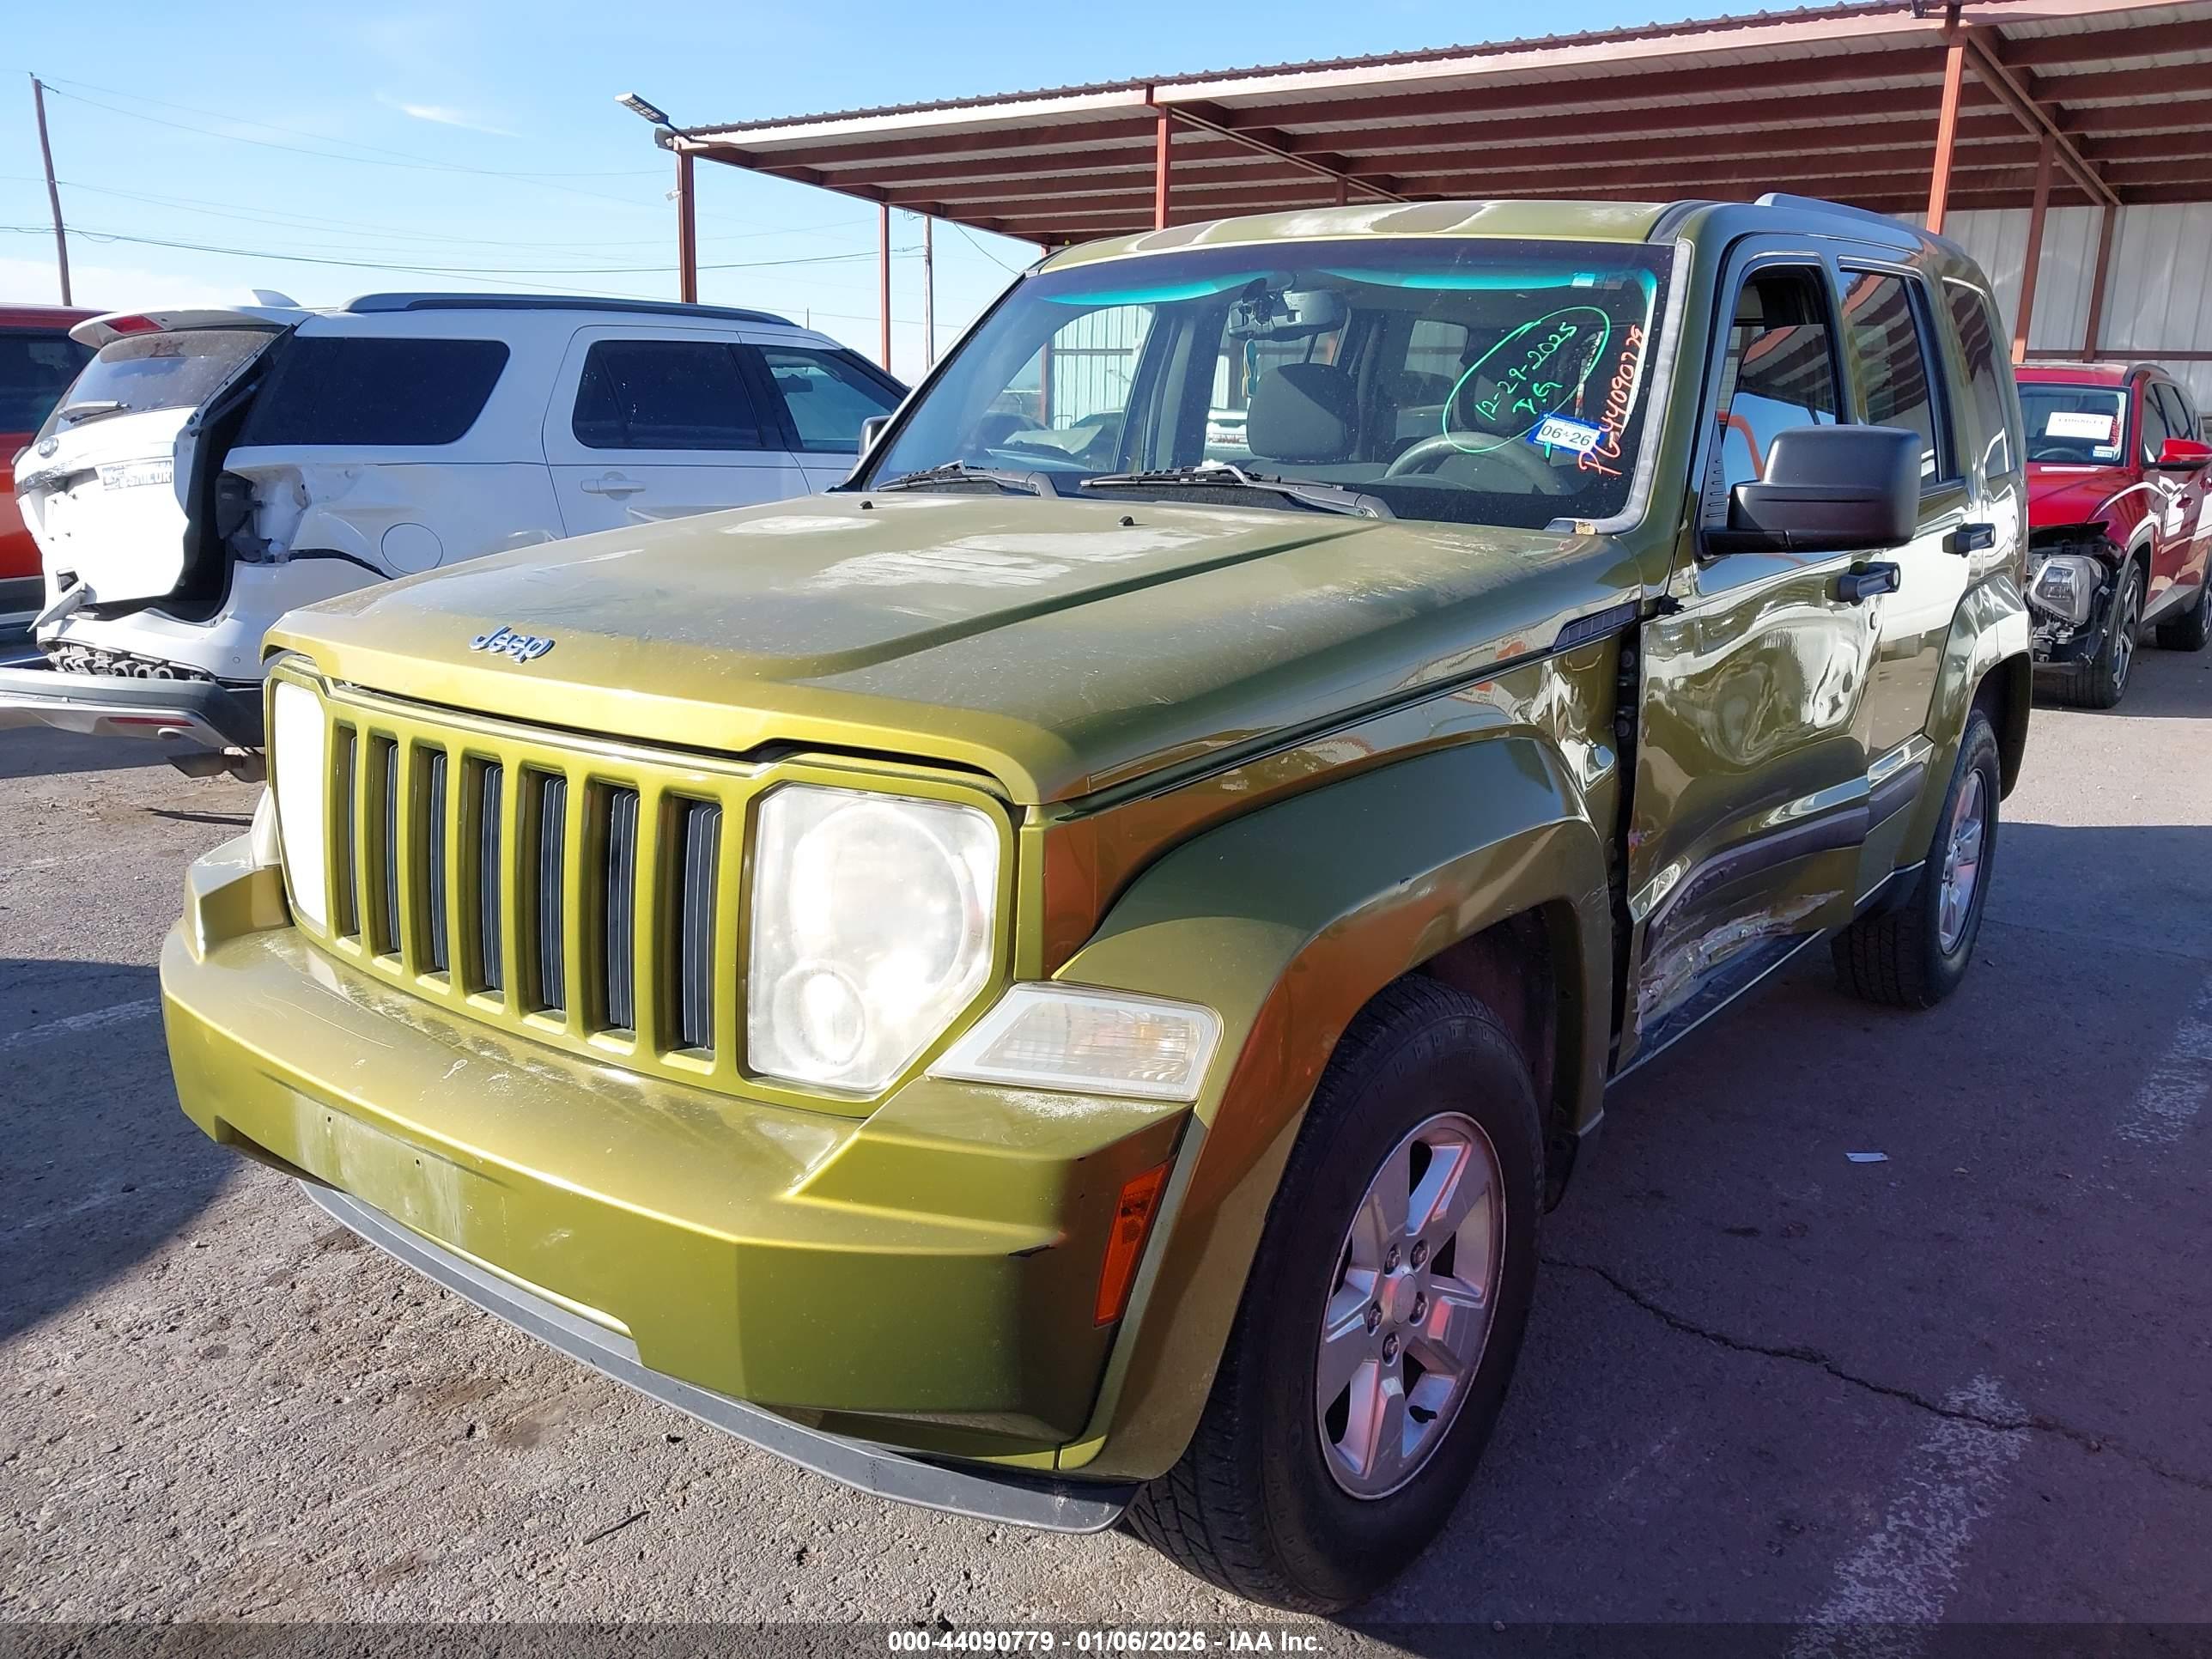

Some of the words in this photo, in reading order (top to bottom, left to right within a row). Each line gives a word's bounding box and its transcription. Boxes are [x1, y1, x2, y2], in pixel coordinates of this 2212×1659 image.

[1475, 322, 1577, 421] 12-29-2025
[1540, 425, 1563, 439] 06
[1569, 432, 1592, 447] 26
[469, 625, 556, 664] Jeep
